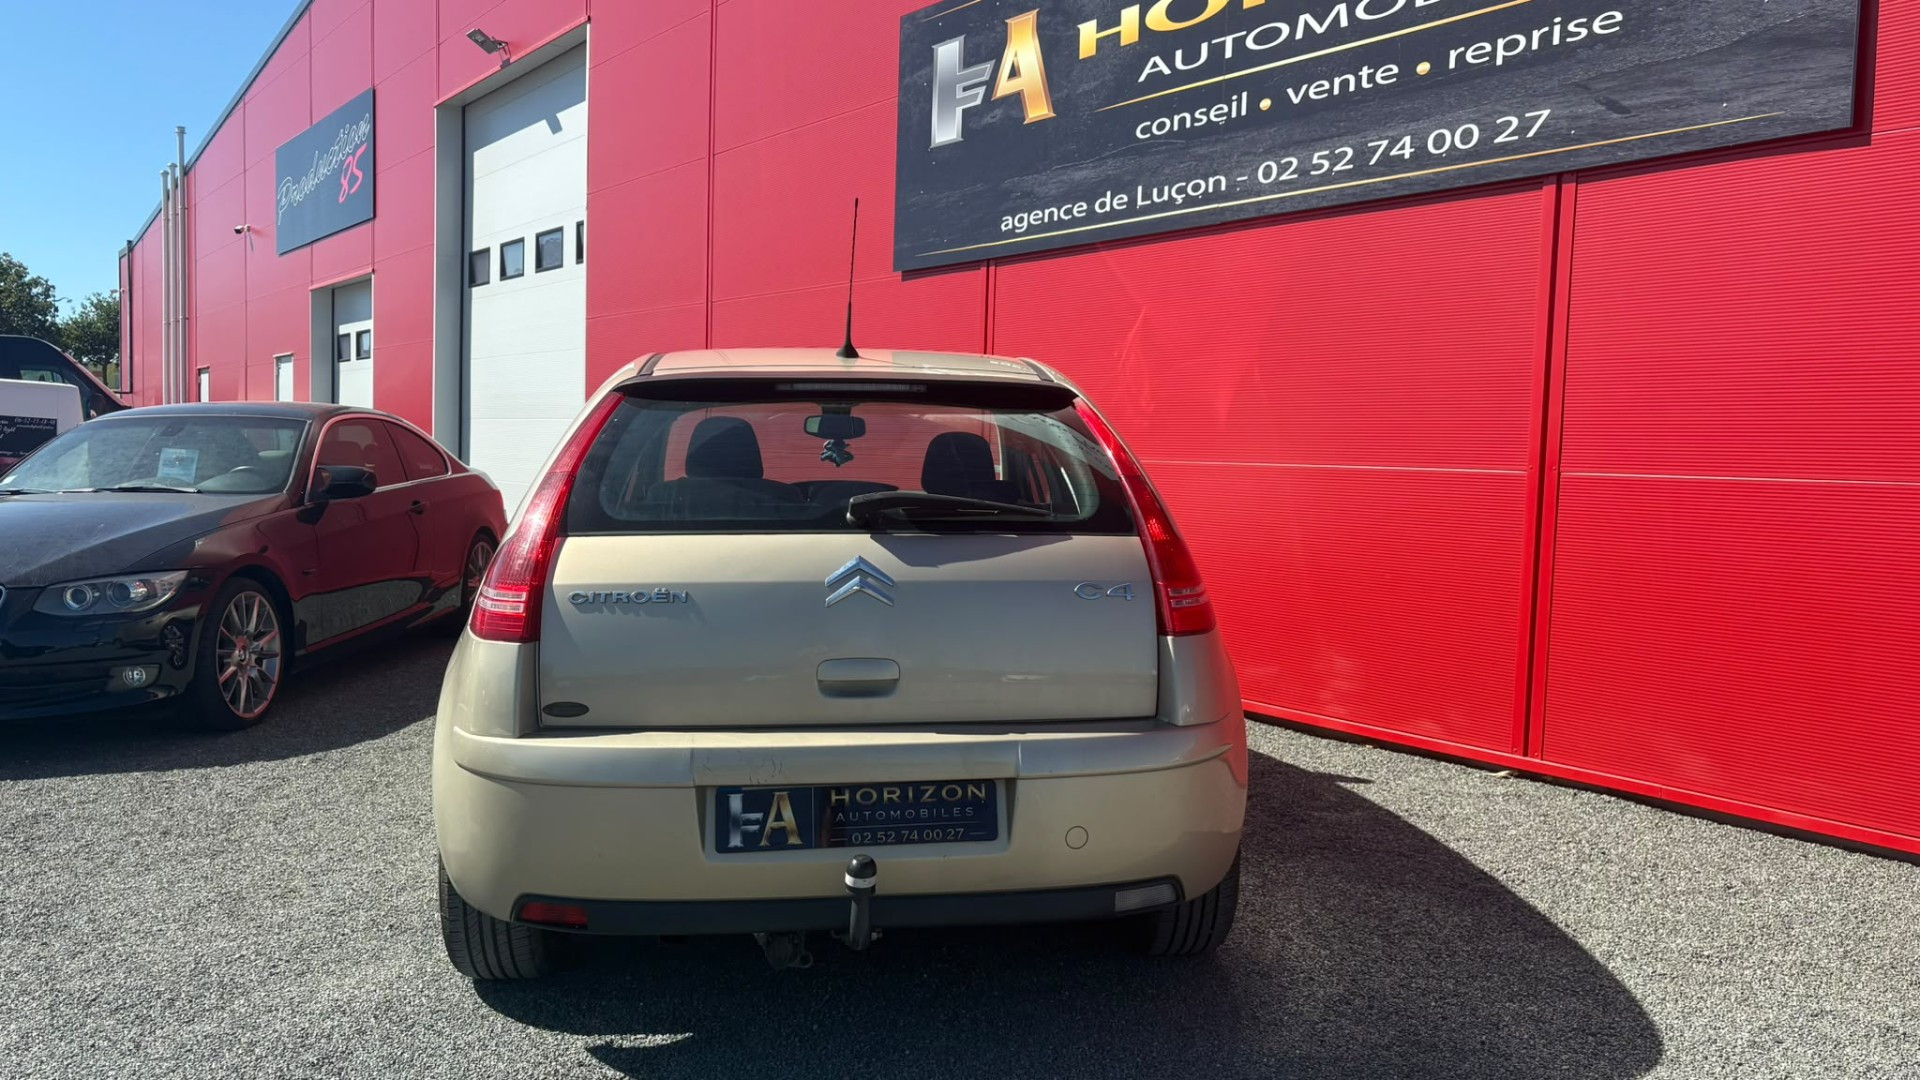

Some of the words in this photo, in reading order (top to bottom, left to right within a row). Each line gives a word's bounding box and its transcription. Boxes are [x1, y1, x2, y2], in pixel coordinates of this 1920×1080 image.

[1077, 0, 1266, 60] HO
[1138, 0, 1440, 83] AUTOMO
[1135, 92, 1247, 139] conseil
[1286, 63, 1399, 104] vente
[1448, 9, 1623, 69] reprise
[277, 112, 371, 226] Production
[338, 142, 368, 204] 85
[1001, 202, 1087, 232] agence
[1094, 191, 1128, 213] de
[1137, 175, 1227, 206] Luçon
[1257, 157, 1298, 184] 02
[1310, 147, 1354, 175] 52
[1367, 135, 1414, 165] 74
[1427, 124, 1479, 154] 00
[1494, 109, 1551, 143] 27
[568, 587, 689, 604] CITROËN
[1074, 582, 1136, 601] C4
[830, 783, 986, 806] HORIZON
[836, 806, 975, 822] AUTOMOBILES
[852, 832, 872, 845] 02
[877, 831, 896, 843] 52
[901, 829, 919, 842] 74
[923, 828, 943, 841] 00
[946, 827, 965, 841] 27
